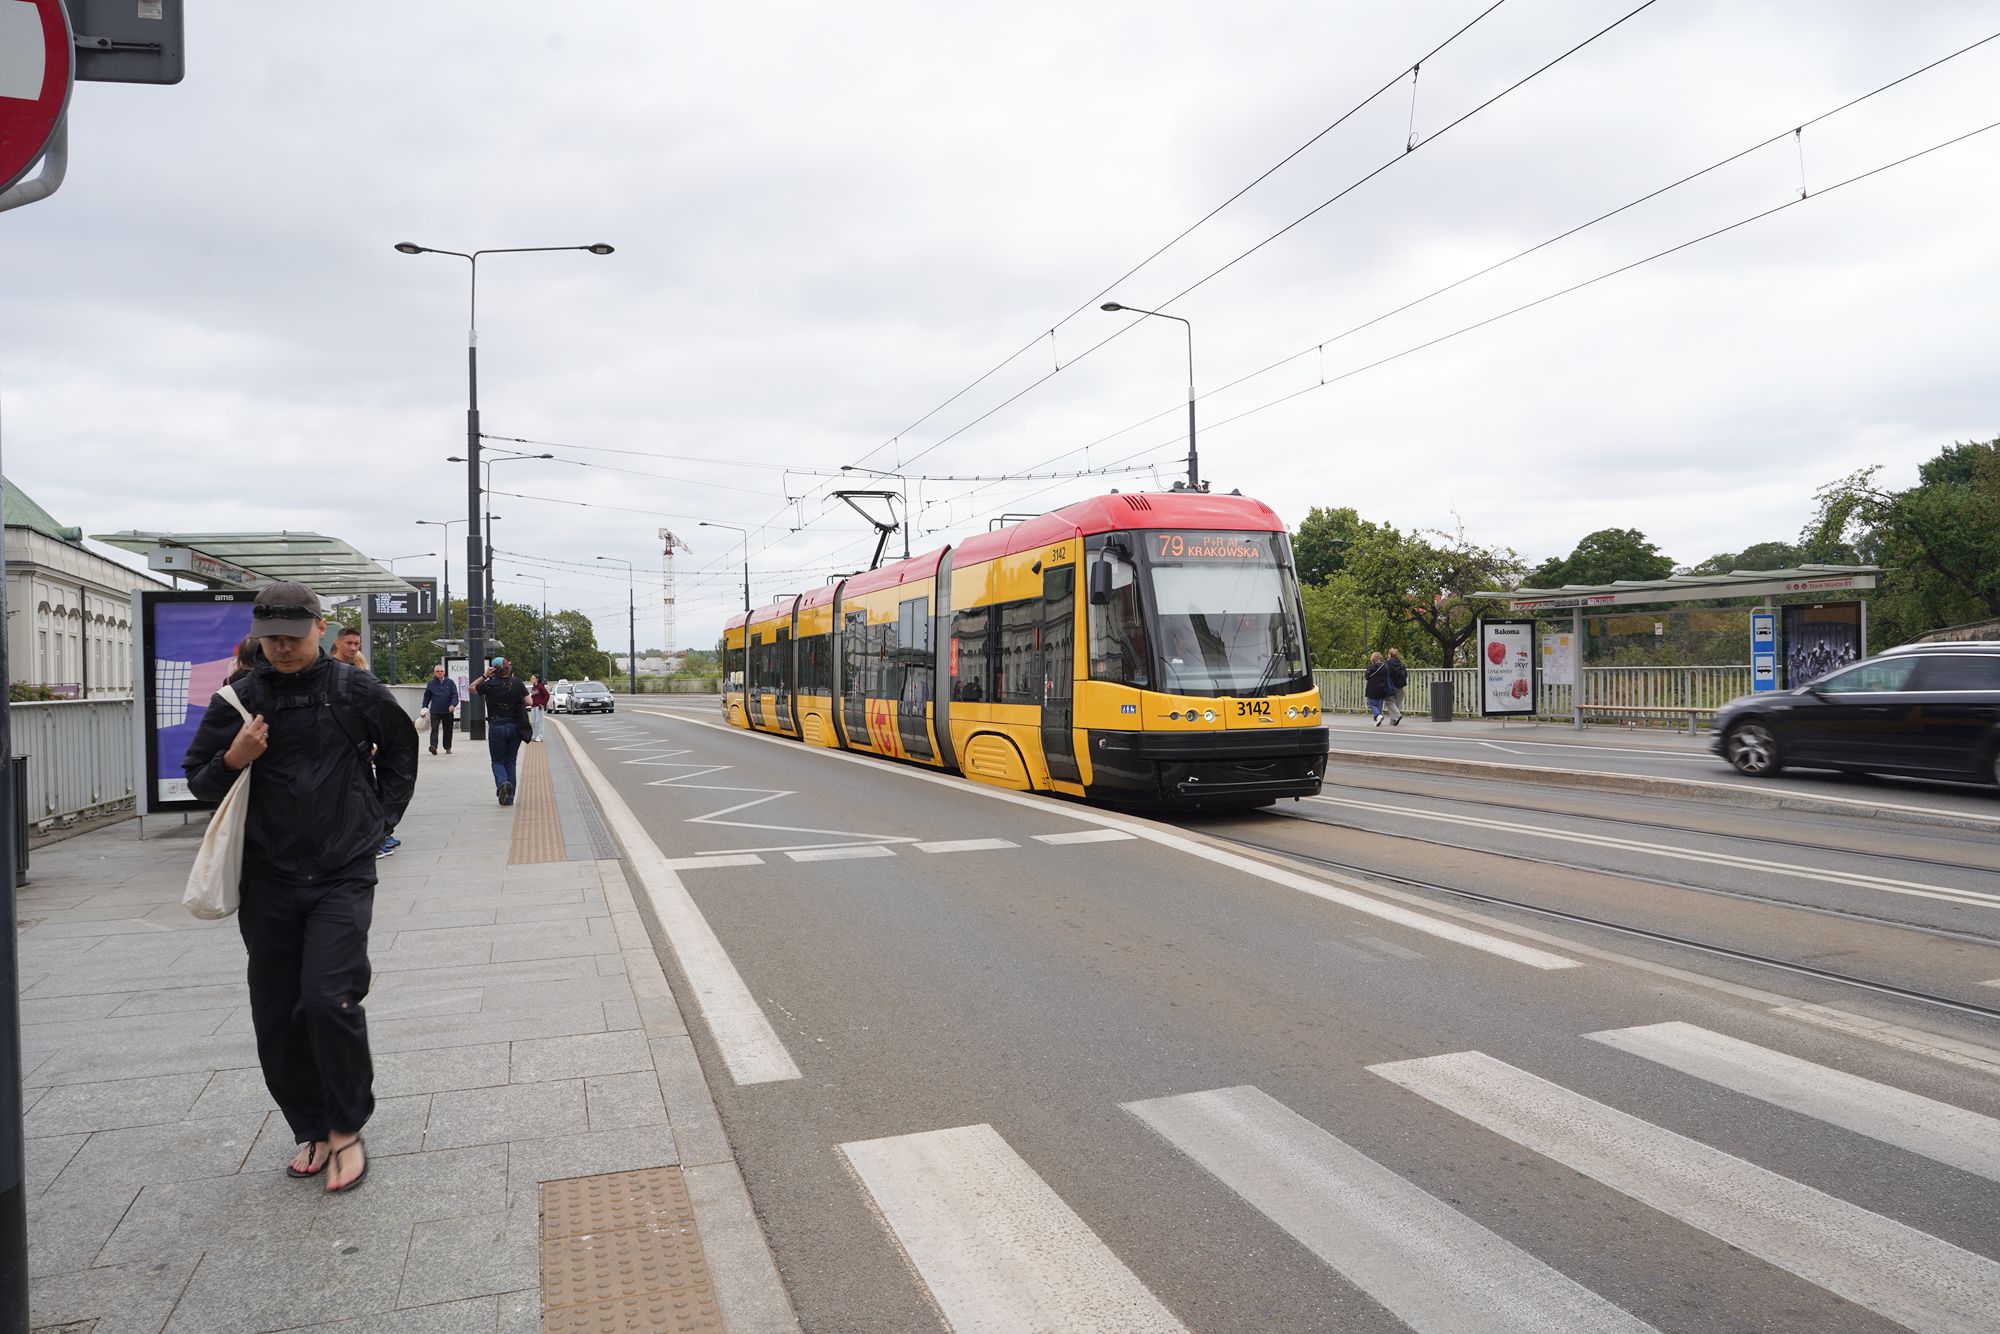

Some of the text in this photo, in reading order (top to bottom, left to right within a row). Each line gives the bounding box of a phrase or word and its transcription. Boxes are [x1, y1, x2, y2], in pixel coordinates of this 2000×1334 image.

[1159, 535, 1184, 557] 79
[1203, 536, 1223, 547] P+R
[1052, 547, 1066, 562] 3142
[1187, 546, 1260, 557] KRAKOWSKA
[451, 664, 469, 672] KÉRA
[1236, 701, 1271, 716] 3142
